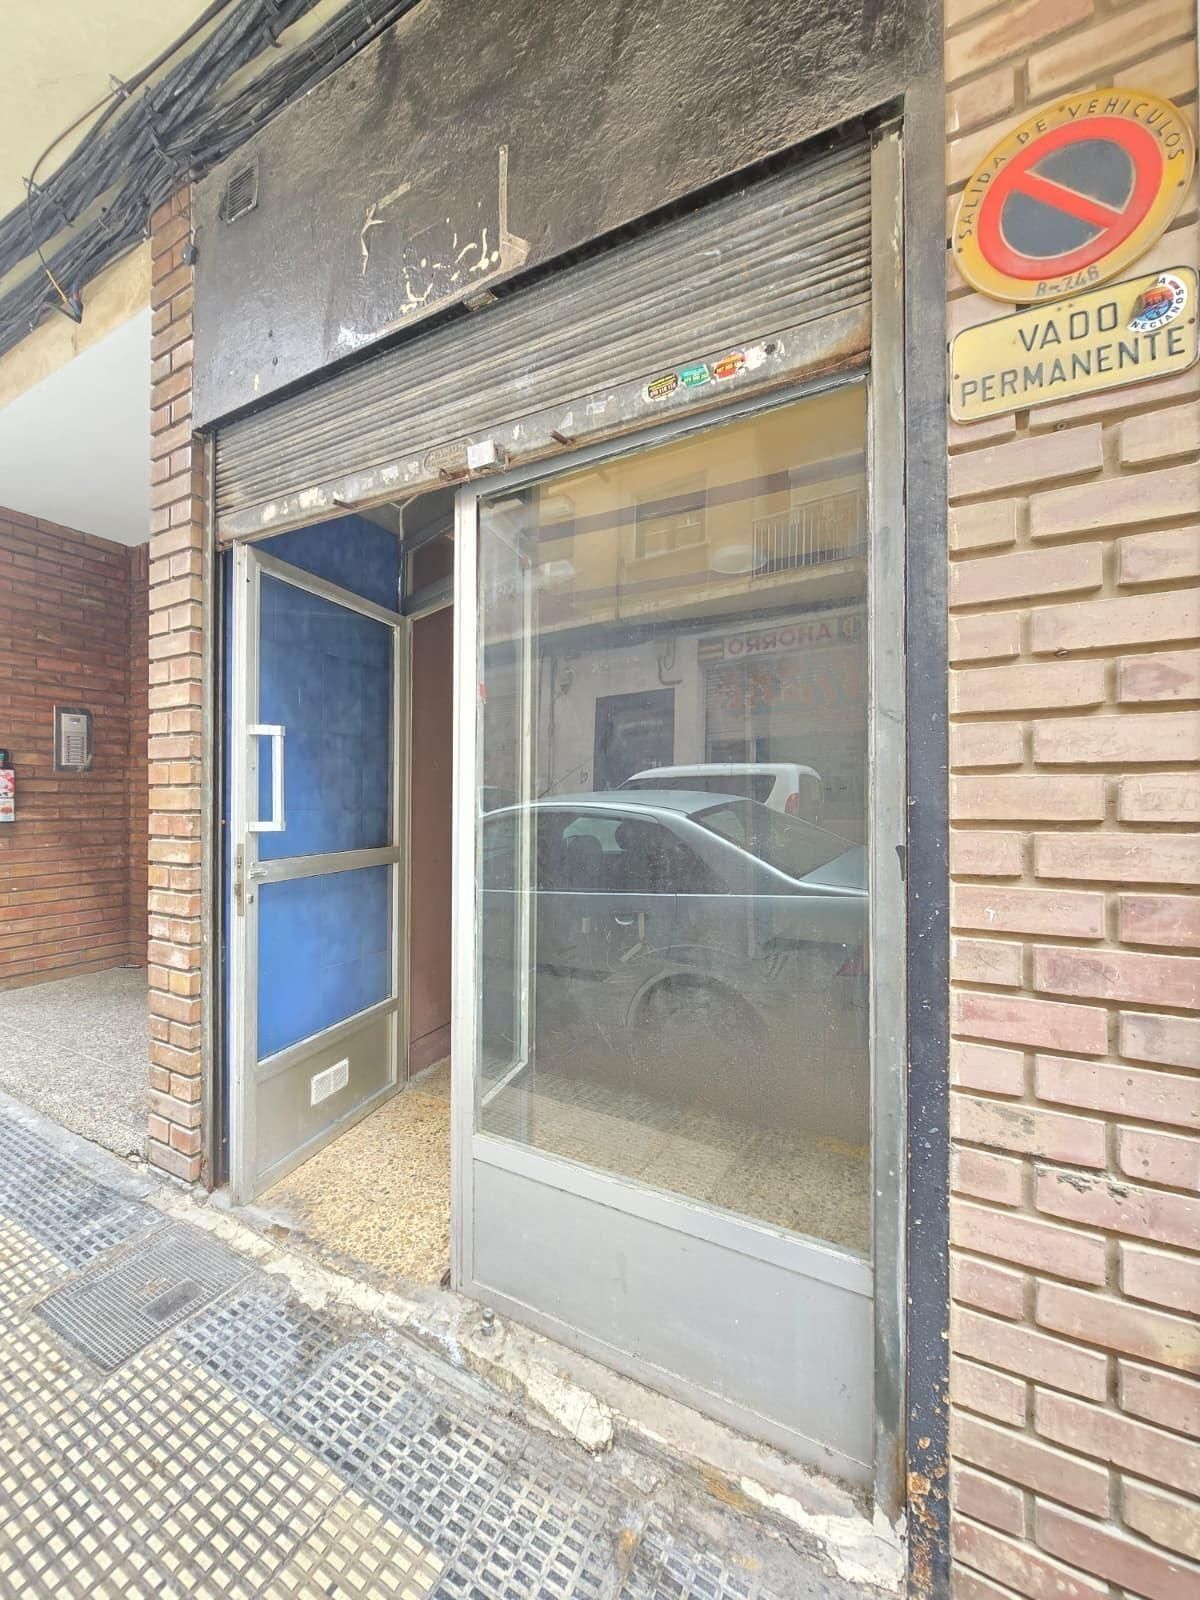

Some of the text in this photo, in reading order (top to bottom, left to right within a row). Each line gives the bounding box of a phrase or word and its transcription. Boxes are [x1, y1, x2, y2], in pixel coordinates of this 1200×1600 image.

[959, 97, 1185, 240] SALIDA DE VEHICULOS
[960, 325, 1186, 408] PERMANENTE
[1018, 302, 1119, 351] VADO
